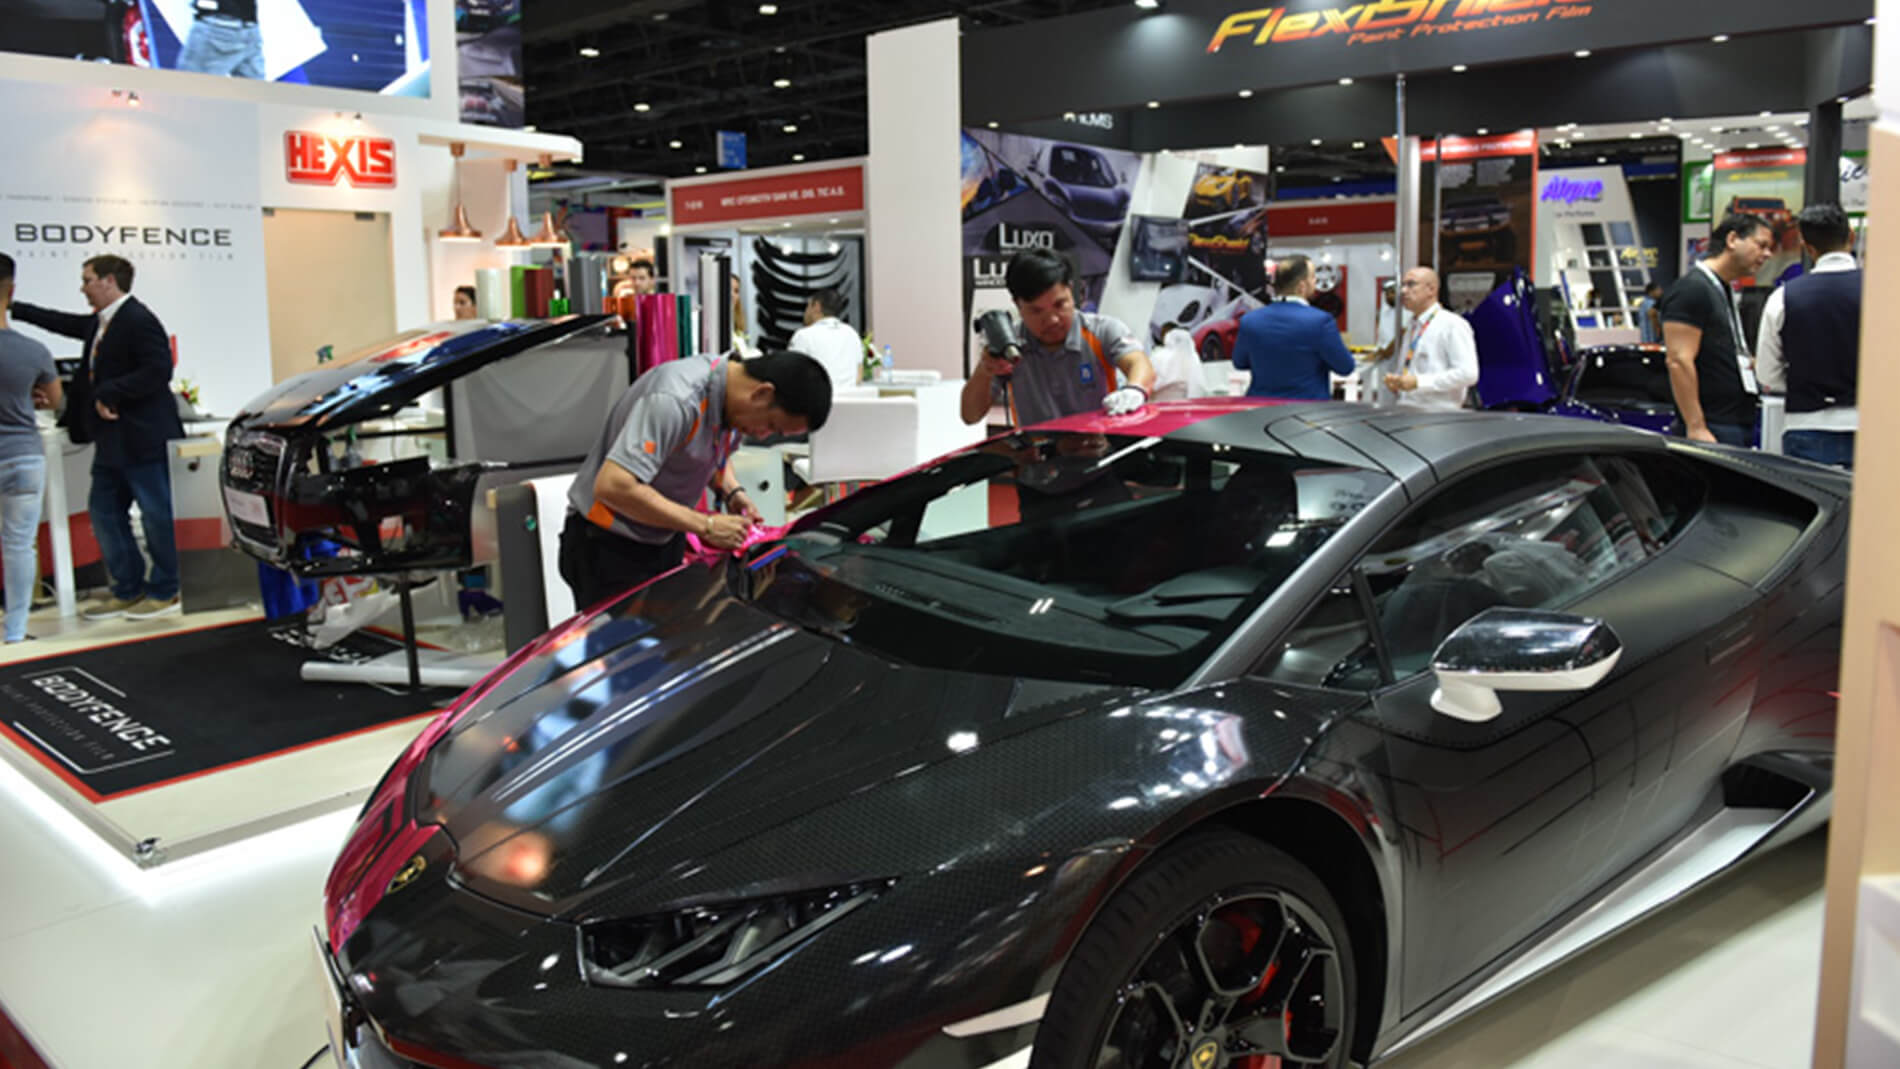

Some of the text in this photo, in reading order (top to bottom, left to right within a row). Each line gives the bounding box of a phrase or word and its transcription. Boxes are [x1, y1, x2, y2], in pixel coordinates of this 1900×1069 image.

[1410, 12, 1540, 38] Protection
[1545, 5, 1593, 20] Film
[286, 132, 395, 186] HEXIS
[15, 223, 232, 247] BODYFENCE
[973, 258, 1008, 278] LU
[32, 675, 171, 751] BODYFENCE
